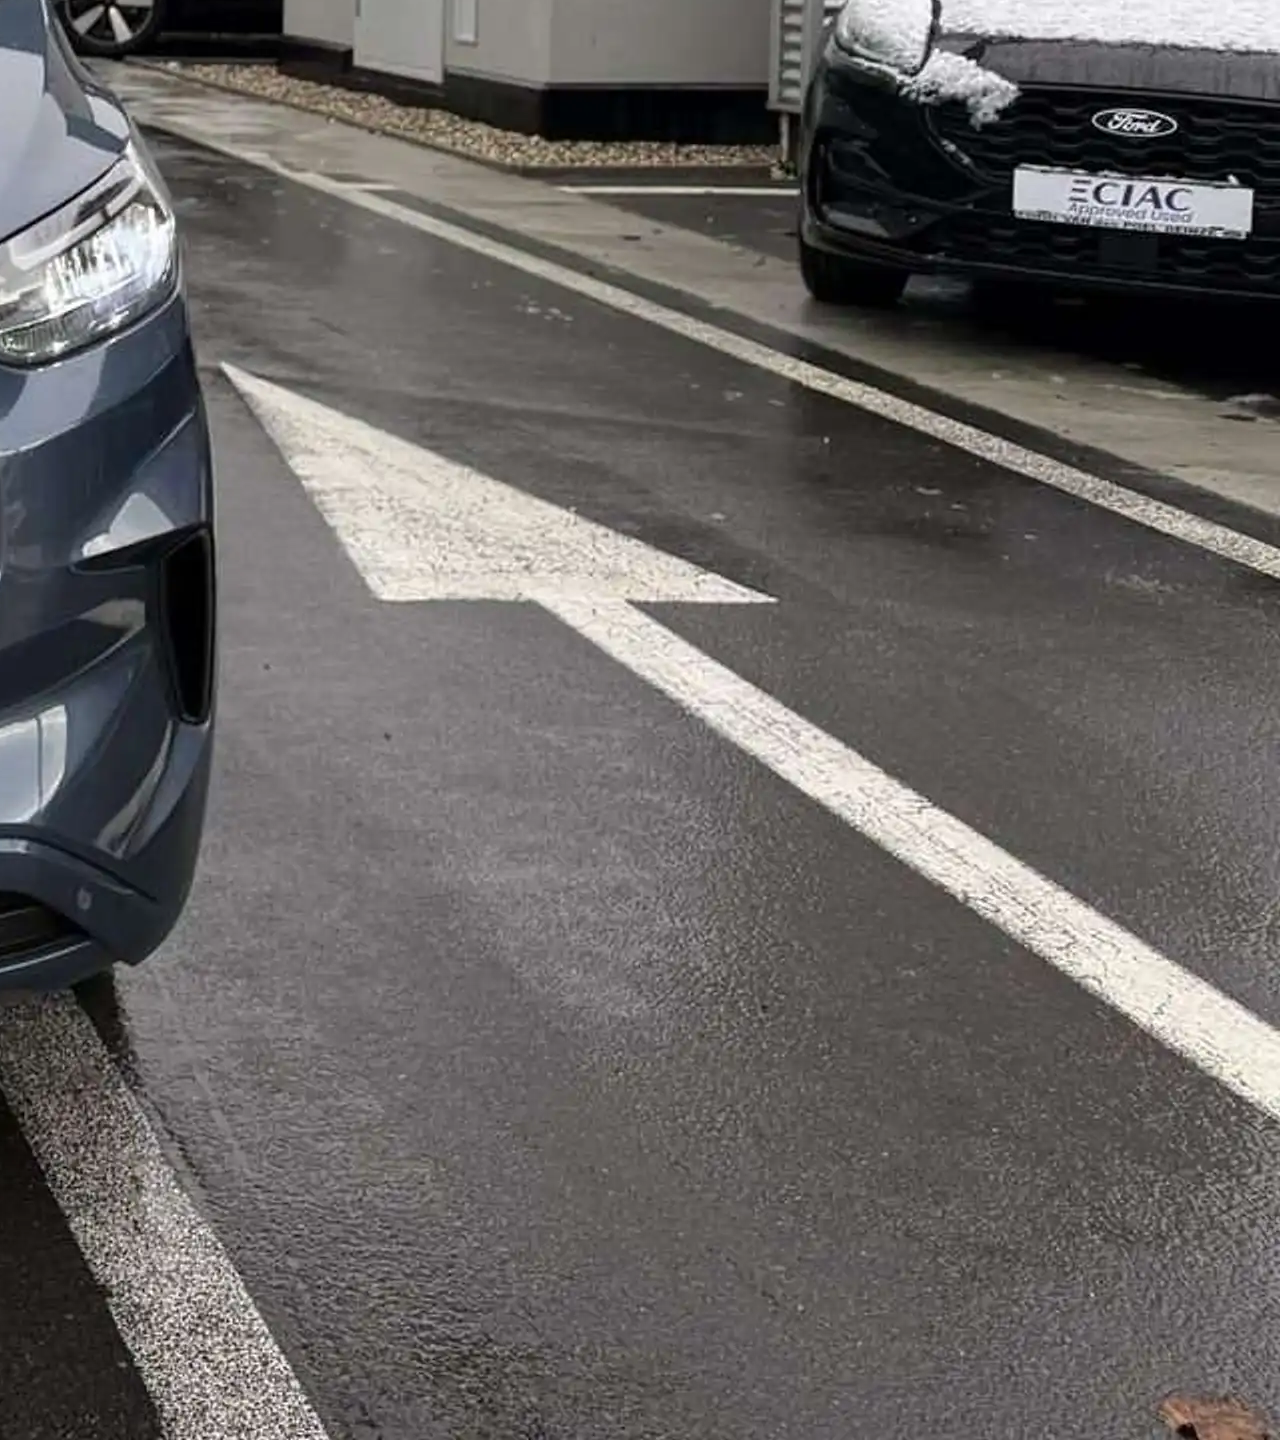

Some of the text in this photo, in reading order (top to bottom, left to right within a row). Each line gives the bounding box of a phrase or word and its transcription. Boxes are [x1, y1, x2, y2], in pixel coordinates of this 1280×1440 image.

[1107, 111, 1162, 134] Ford
[1069, 178, 1193, 212] ECIAC
[1069, 203, 1147, 221] Approved
[1151, 208, 1192, 224] Used
